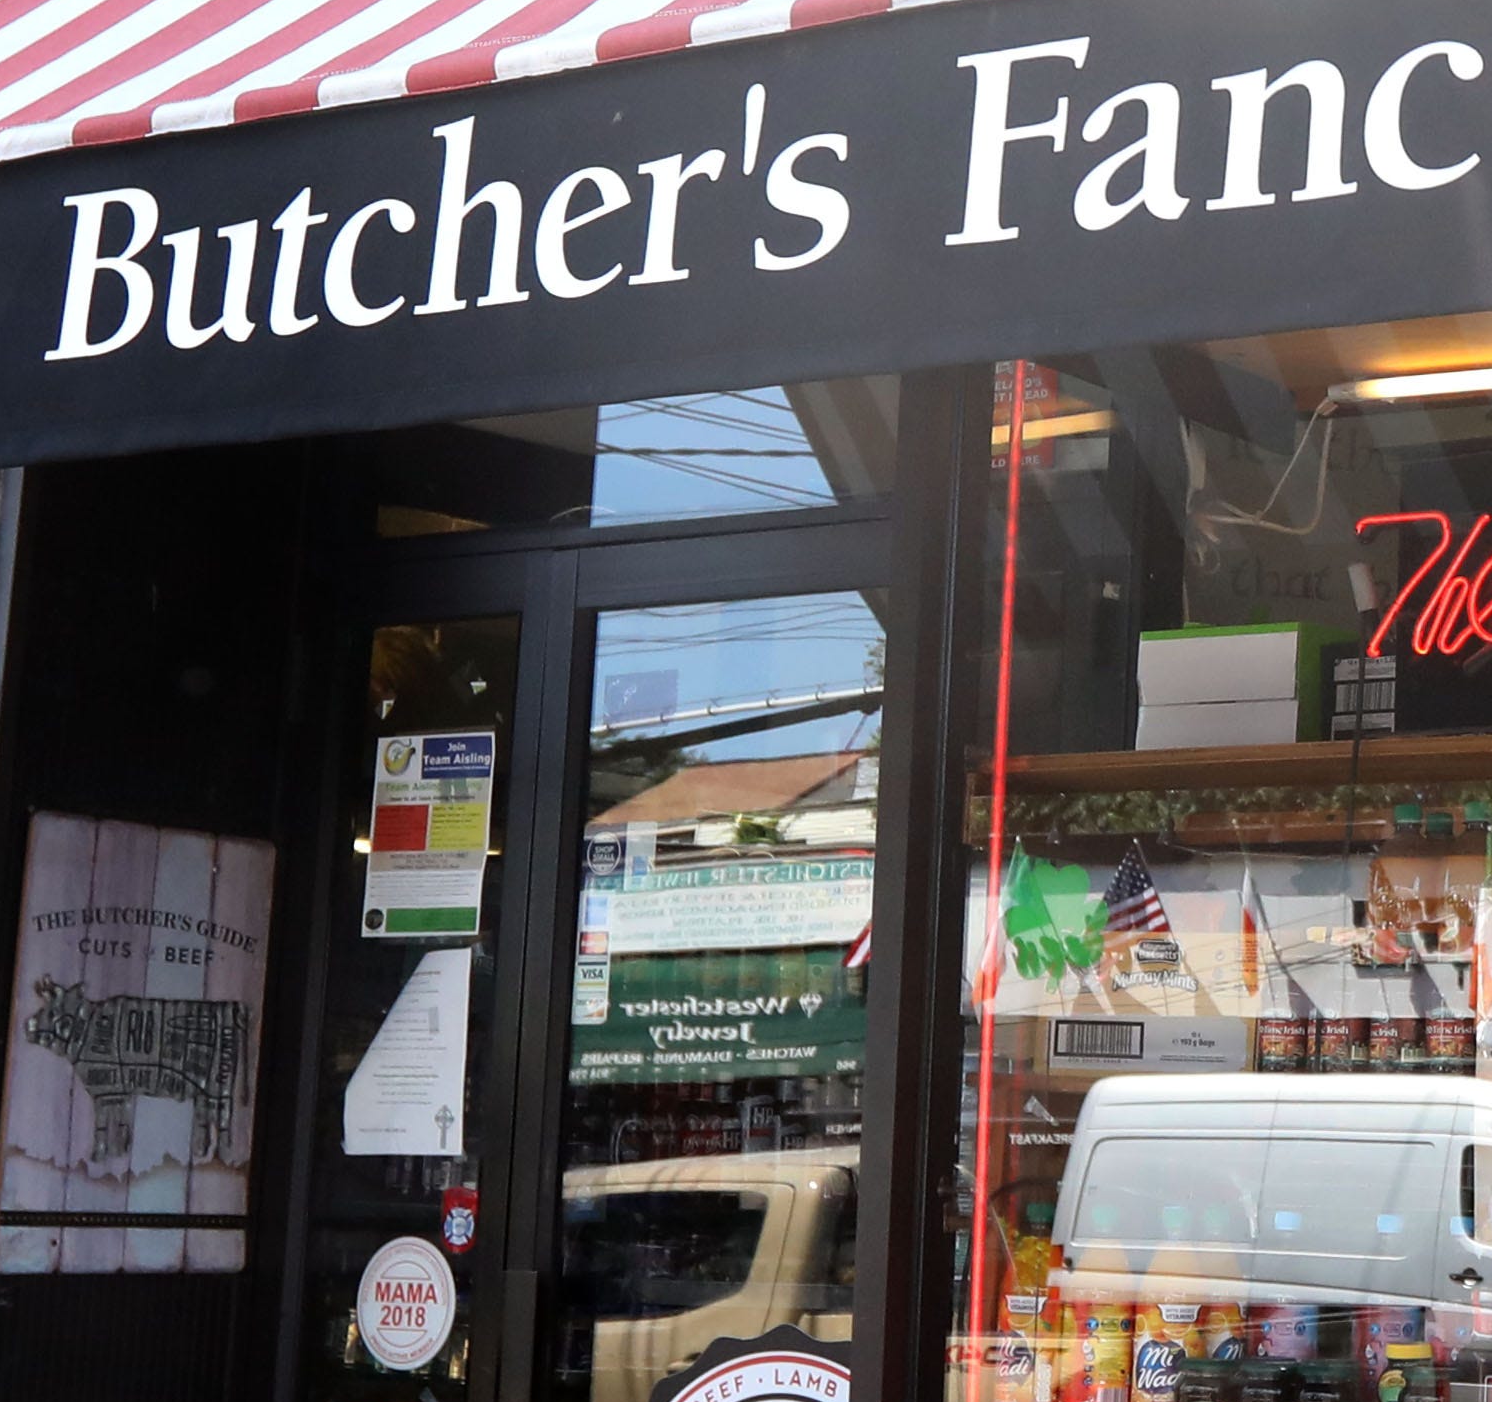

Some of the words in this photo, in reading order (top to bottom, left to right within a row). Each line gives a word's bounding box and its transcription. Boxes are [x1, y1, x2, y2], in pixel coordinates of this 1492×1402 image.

[44, 83, 853, 362] Butcher's
[423, 755, 450, 764] Team
[32, 910, 76, 933] THE
[82, 907, 192, 931] BUTCHER'S
[196, 920, 259, 955] GUIDE
[79, 938, 132, 958] CUTS
[164, 947, 215, 965] BEEF
[581, 968, 604, 980] VISA
[375, 1282, 438, 1304] MAMA
[380, 1306, 425, 1327] 2018
[1143, 1346, 1173, 1368] Mi
[774, 1369, 838, 1399] LAMB
